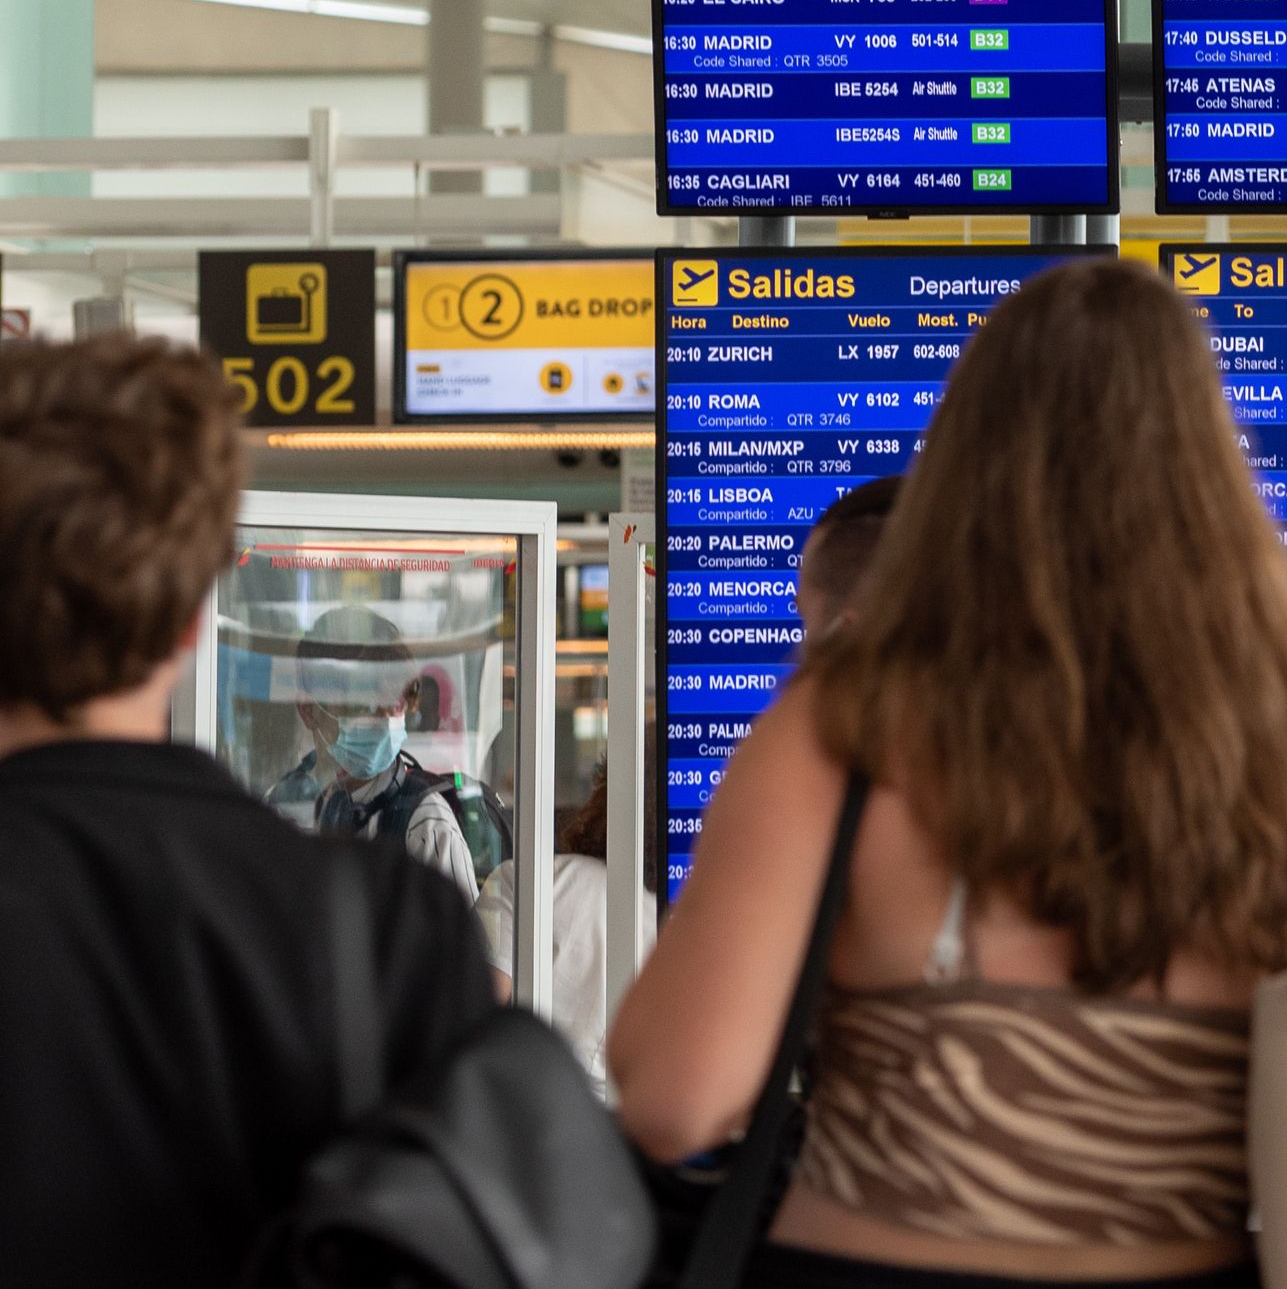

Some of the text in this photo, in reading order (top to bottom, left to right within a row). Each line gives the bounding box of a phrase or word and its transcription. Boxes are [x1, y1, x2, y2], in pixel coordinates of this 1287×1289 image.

[729, 269, 1020, 299] Salidas Departures
[482, 291, 501, 324] 2
[536, 300, 580, 317] BAG
[588, 299, 652, 316] DROP
[668, 345, 959, 361] 20:10 ZURICH LX 1957 602-608
[221, 356, 355, 413] 502
[400, 560, 450, 571] SEGURIDAD
